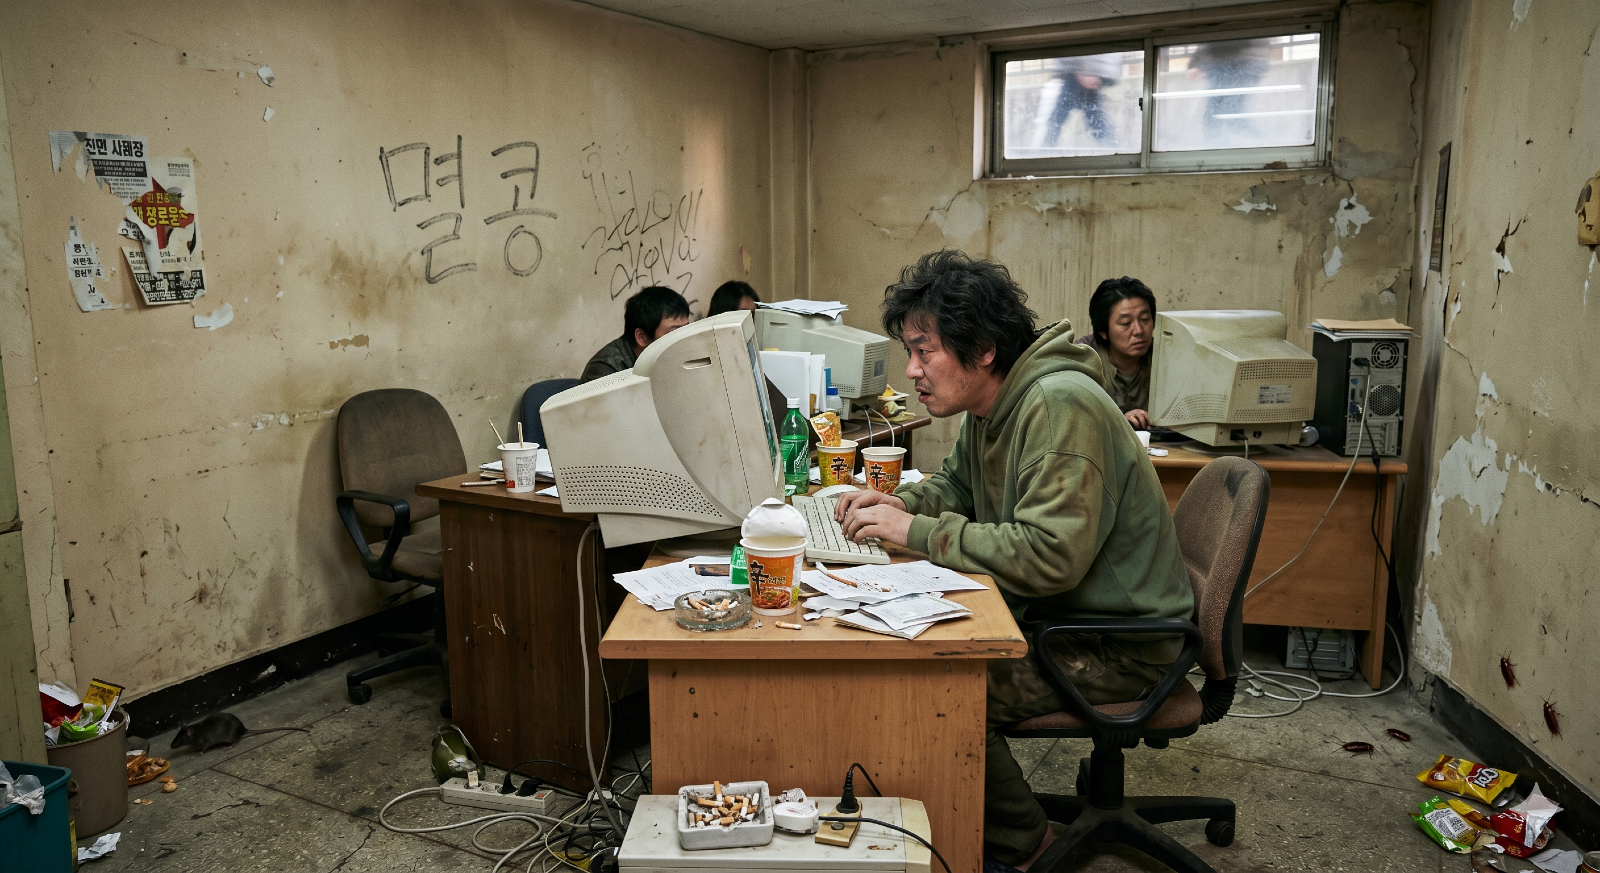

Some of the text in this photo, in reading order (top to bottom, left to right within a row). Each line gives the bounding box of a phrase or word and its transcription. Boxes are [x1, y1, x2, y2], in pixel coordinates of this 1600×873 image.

[830, 456, 848, 480] 辛
[869, 463, 887, 489] 辛
[749, 561, 769, 596] 辛
